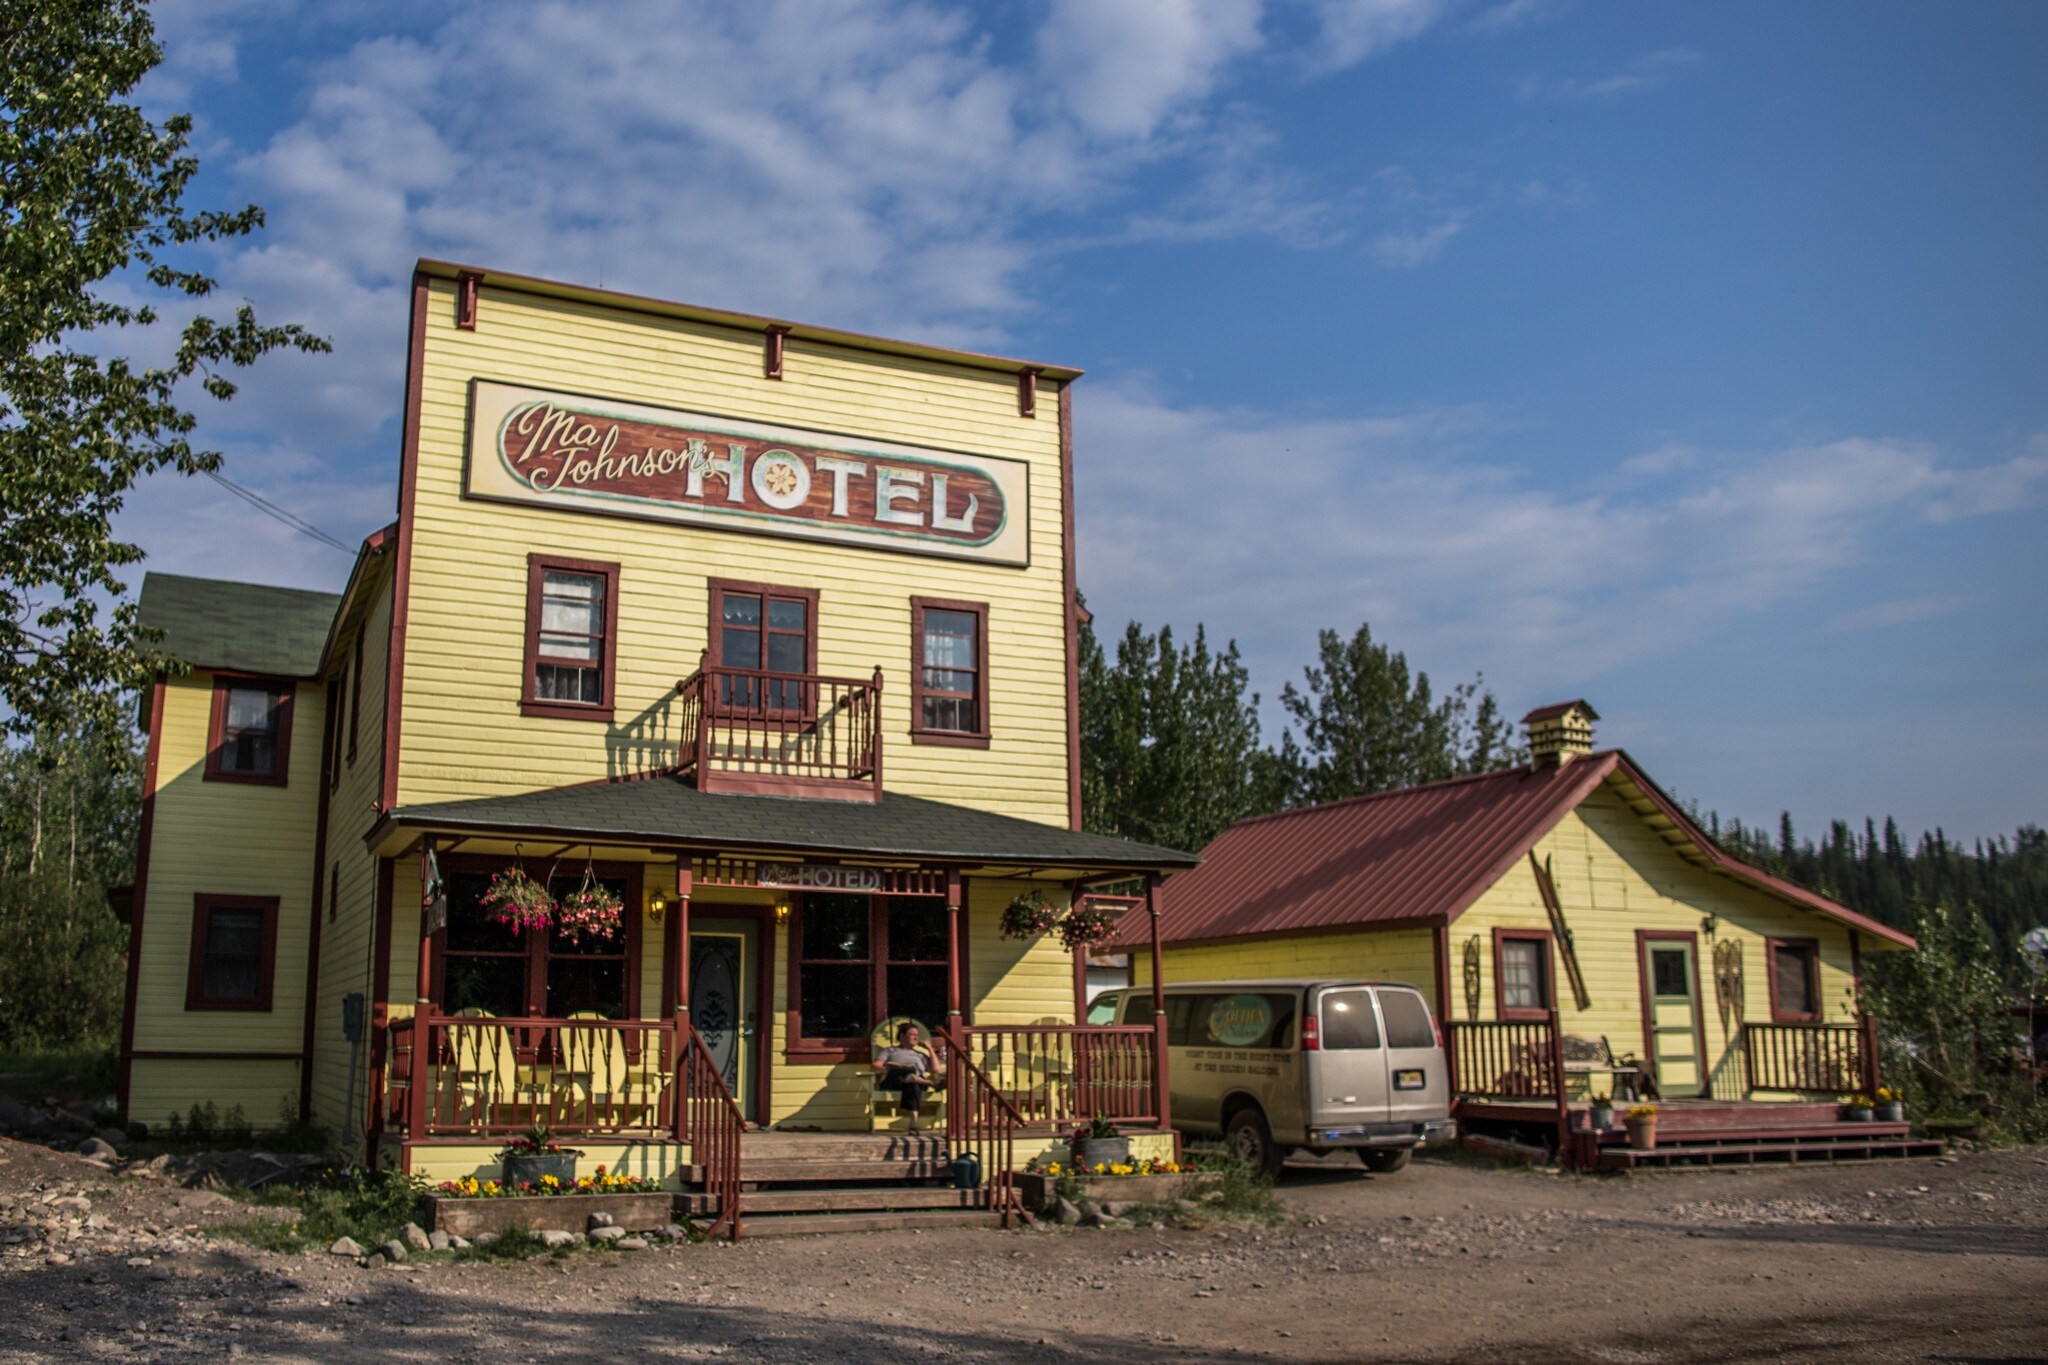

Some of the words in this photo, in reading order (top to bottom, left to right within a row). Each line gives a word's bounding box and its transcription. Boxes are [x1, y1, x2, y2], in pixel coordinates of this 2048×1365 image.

[517, 400, 601, 465] Ma
[529, 424, 729, 493] Johnson's
[683, 437, 980, 534] HOTEL
[799, 866, 874, 889] HOTEL
[1204, 1063, 1217, 1072] THE
